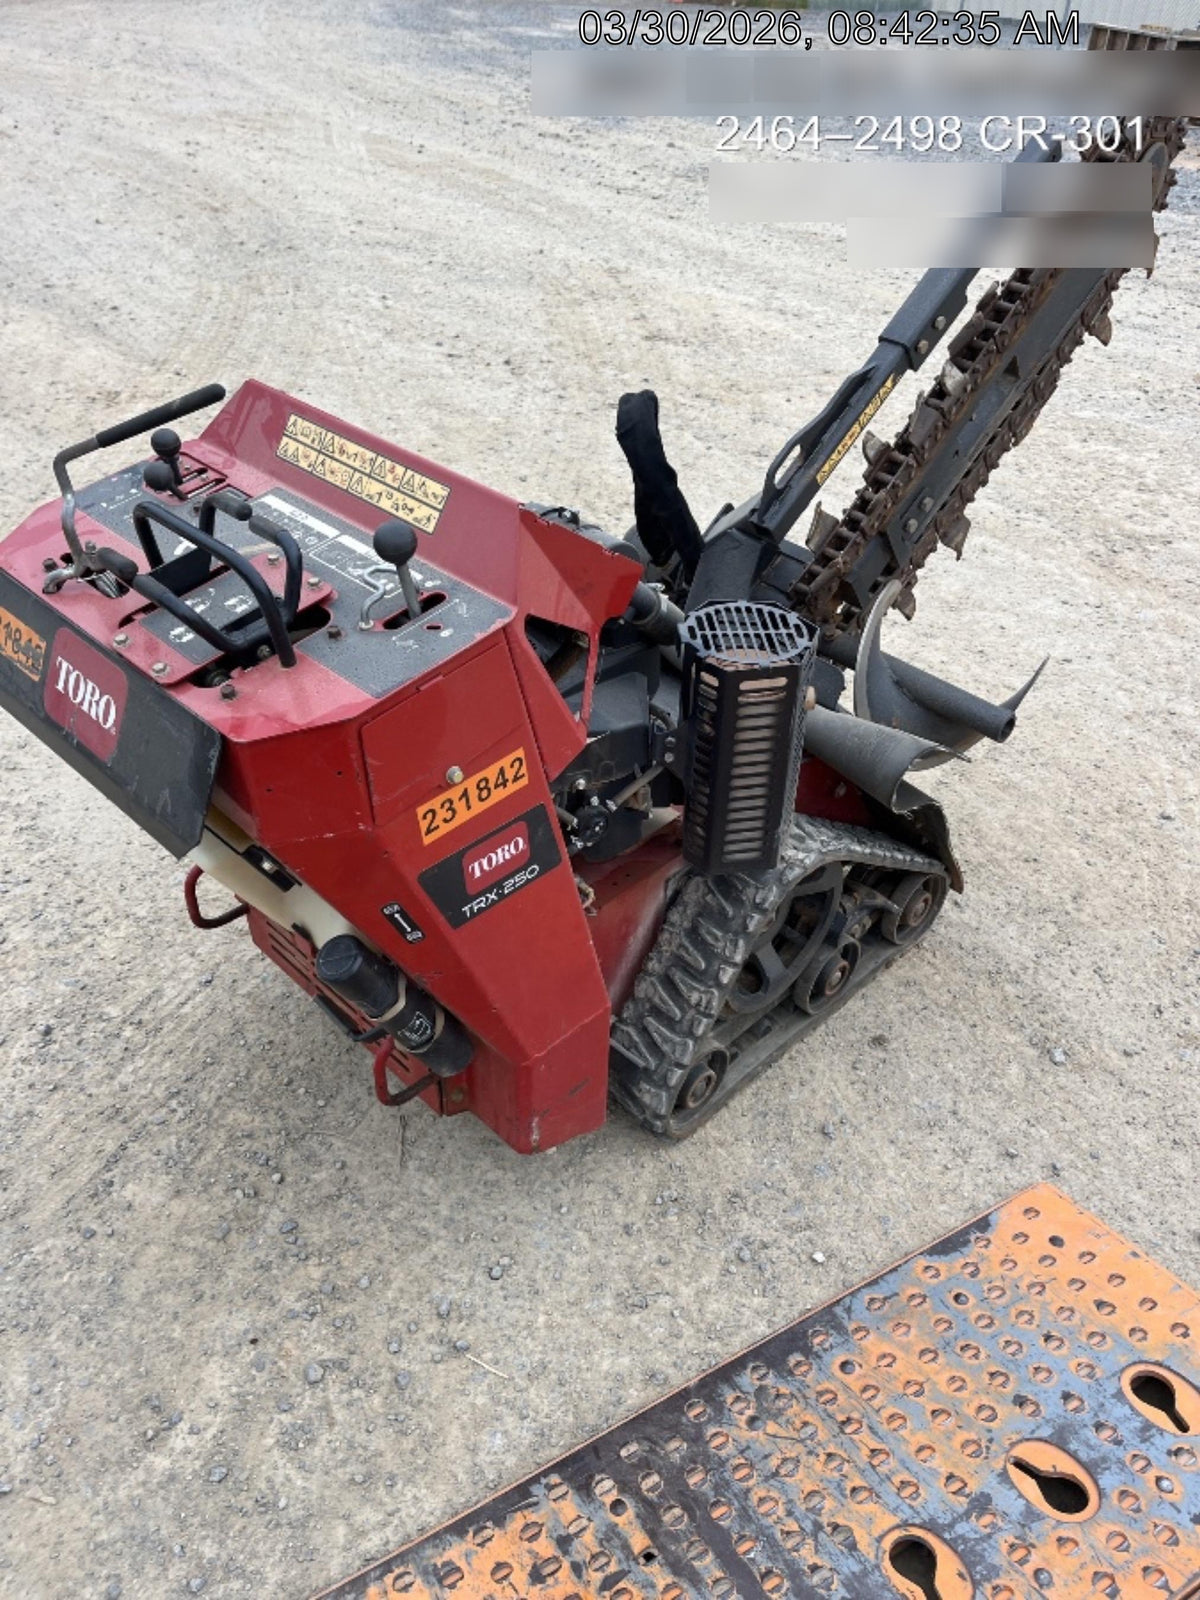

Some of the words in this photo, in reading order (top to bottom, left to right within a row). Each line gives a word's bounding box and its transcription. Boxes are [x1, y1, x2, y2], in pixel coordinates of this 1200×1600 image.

[56, 655, 116, 729] TORO
[422, 757, 526, 836] 231842
[468, 836, 524, 879] TORO
